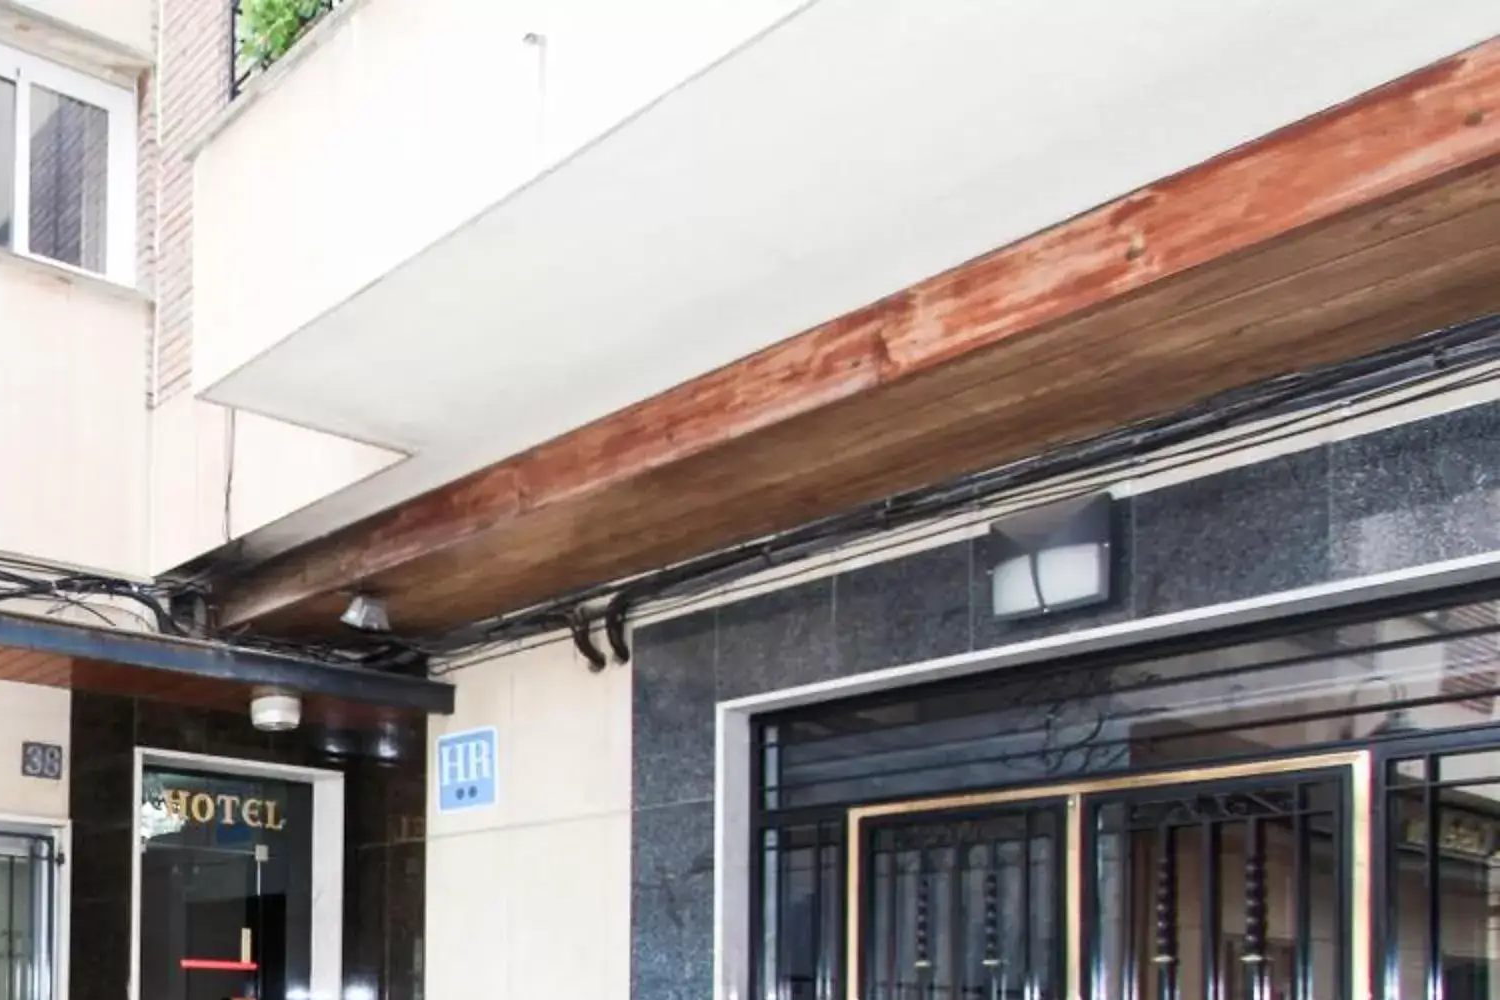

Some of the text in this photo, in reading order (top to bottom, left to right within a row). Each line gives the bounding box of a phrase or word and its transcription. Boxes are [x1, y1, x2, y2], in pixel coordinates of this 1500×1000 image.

[25, 746, 60, 777] 38
[441, 739, 492, 786] HR
[163, 788, 287, 829] HOTEL
